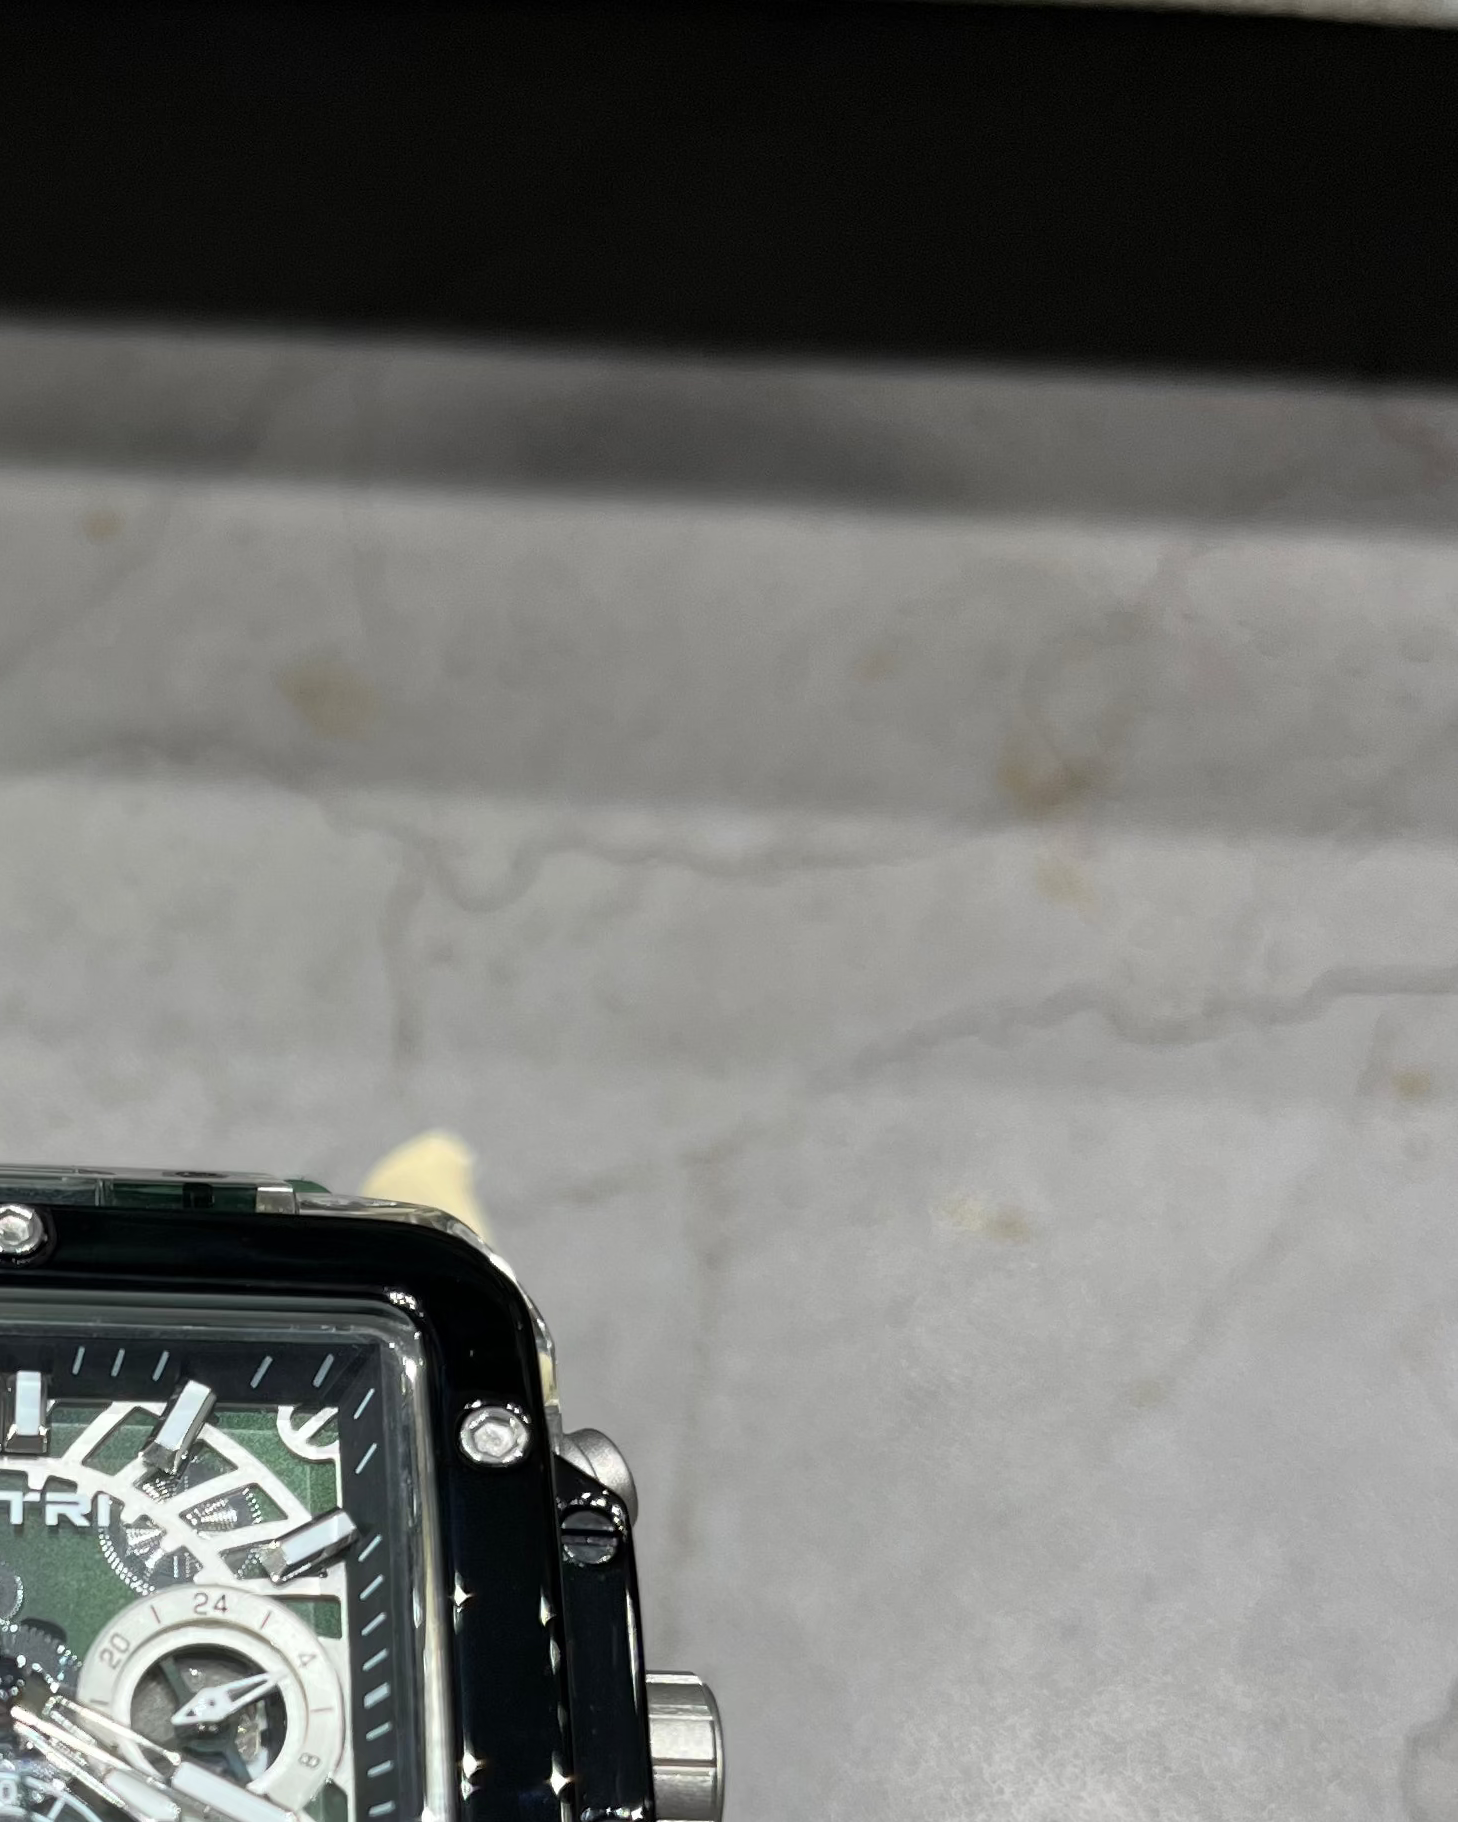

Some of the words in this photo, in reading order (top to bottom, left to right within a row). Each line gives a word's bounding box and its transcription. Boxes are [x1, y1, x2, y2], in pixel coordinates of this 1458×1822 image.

[194, 1592, 228, 1615] 24
[99, 1632, 130, 1670] 20
[296, 1651, 318, 1668] 4
[299, 1752, 320, 1769] 8
